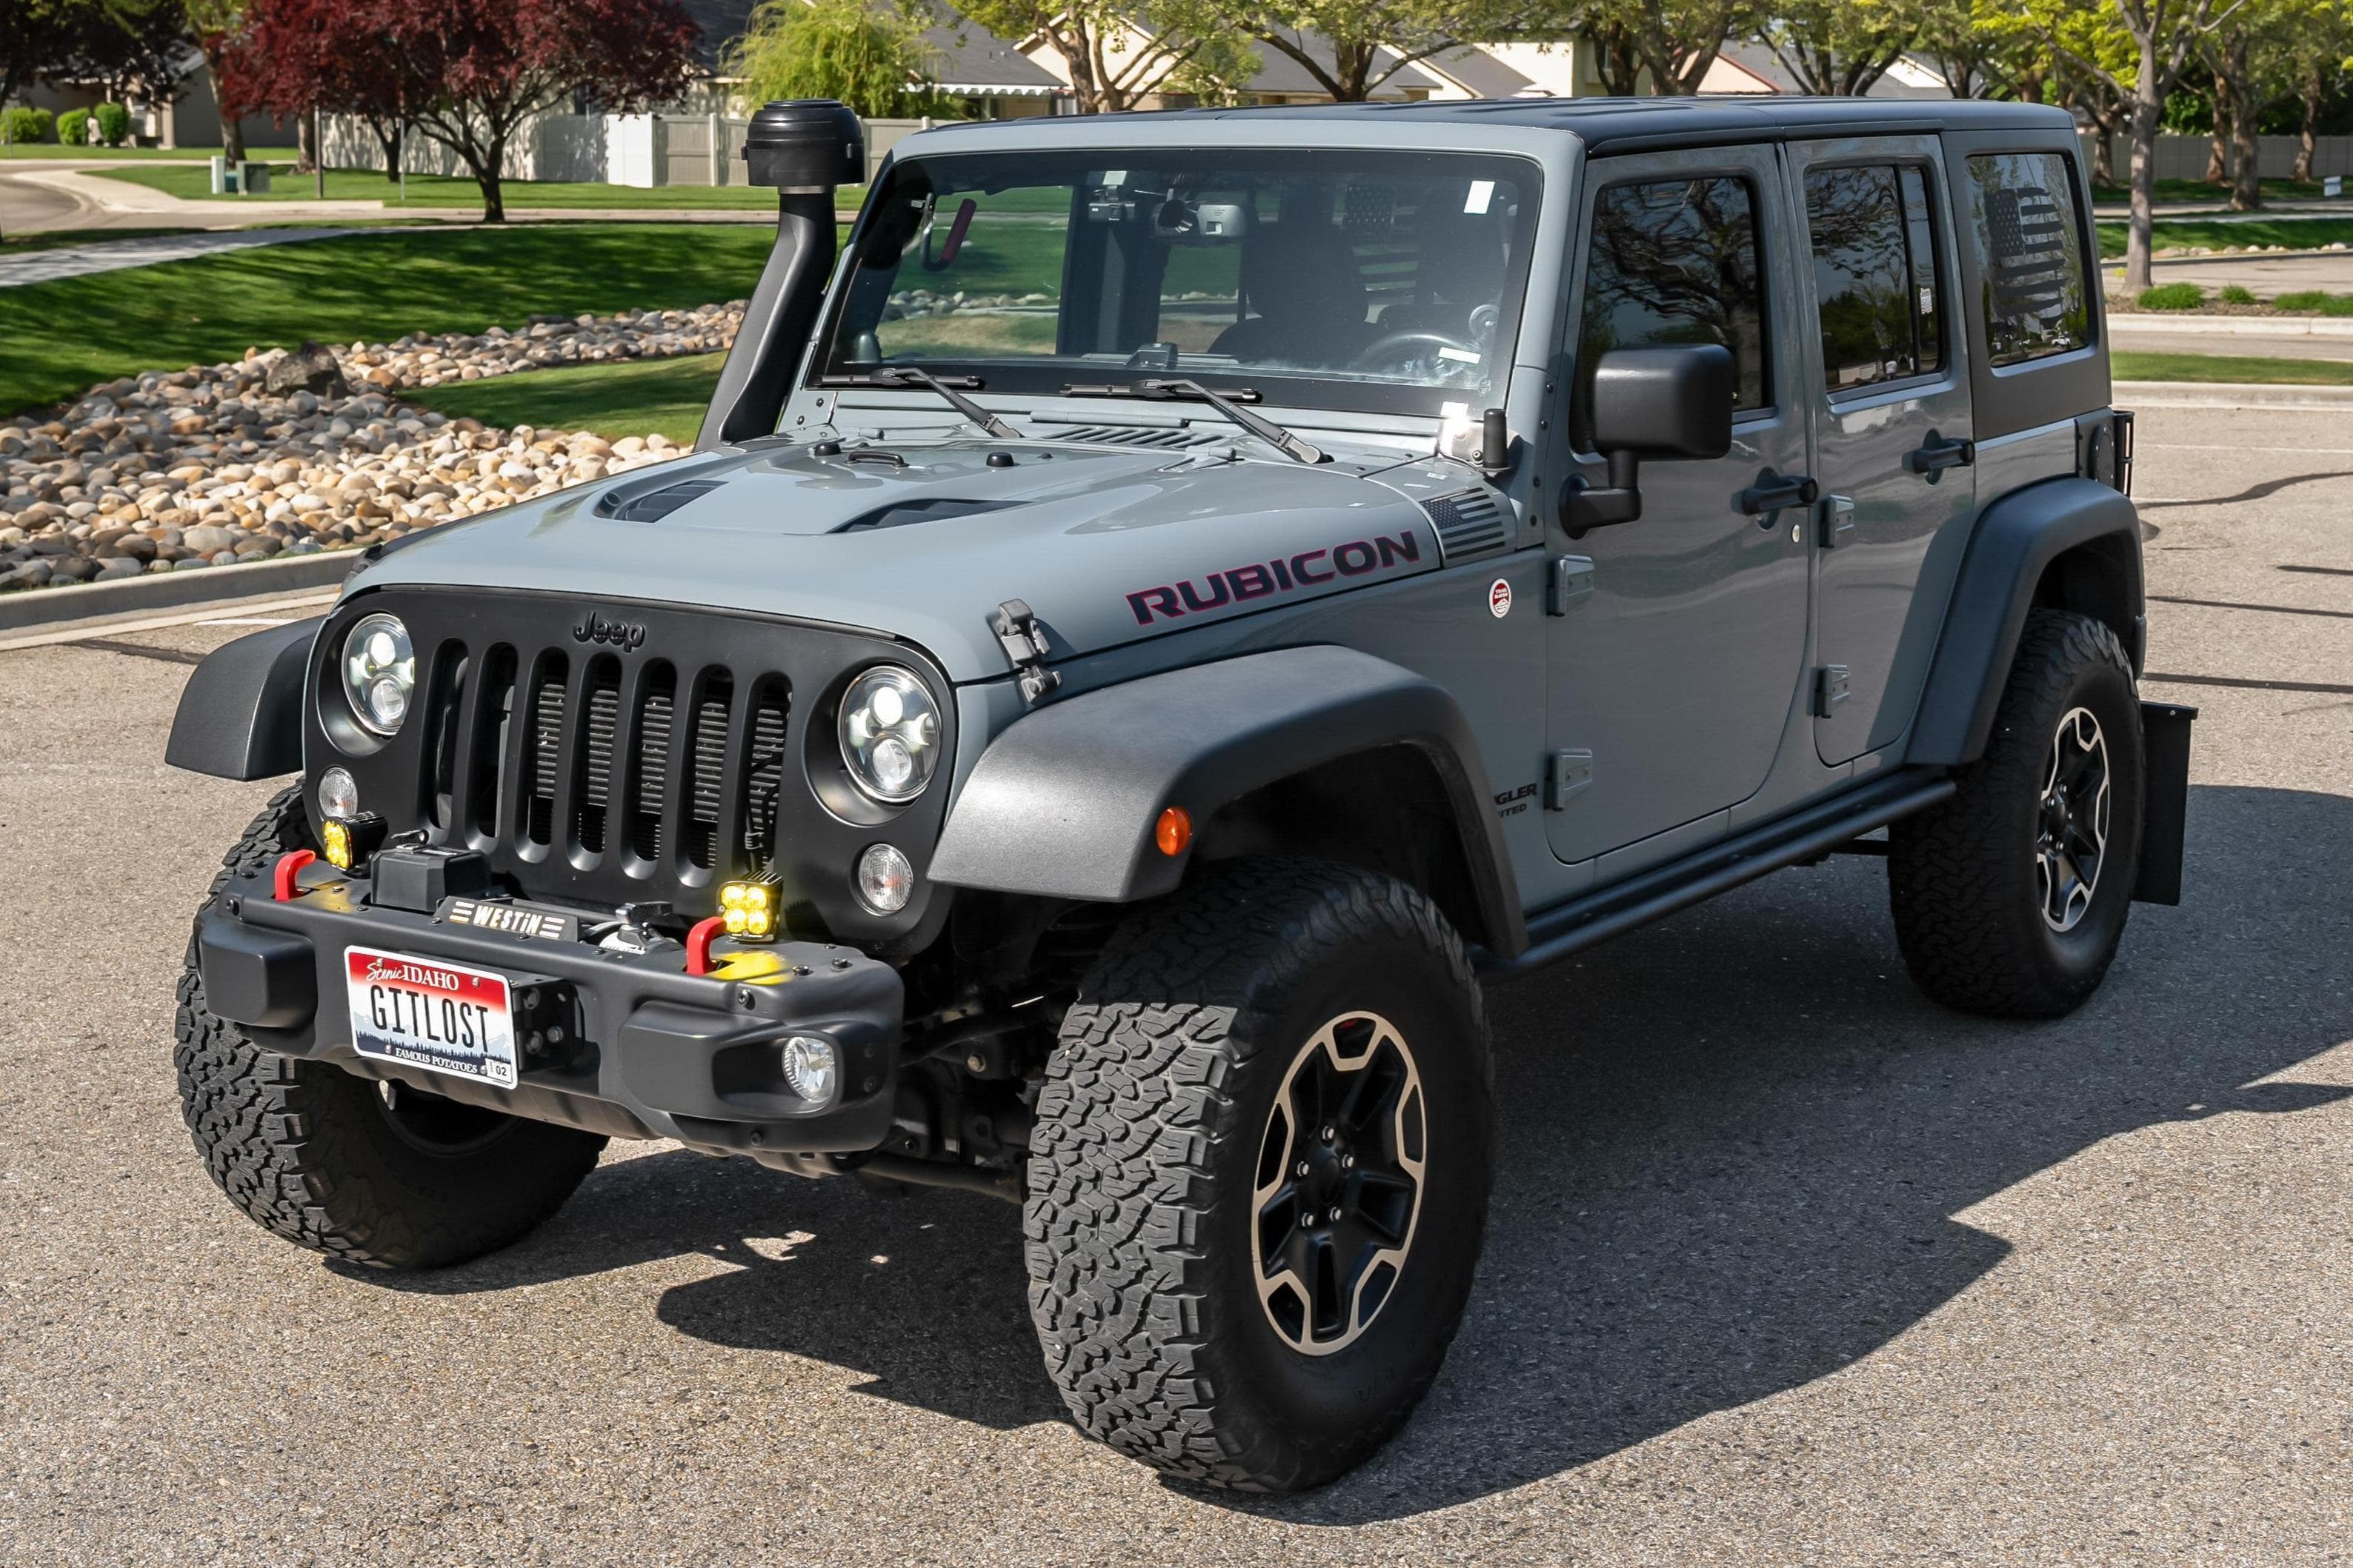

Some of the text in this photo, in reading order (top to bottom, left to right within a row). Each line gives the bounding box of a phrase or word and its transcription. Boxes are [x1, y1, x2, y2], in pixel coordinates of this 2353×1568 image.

[1125, 530, 1420, 626] RUBICON
[573, 612, 645, 653] Jeep
[1498, 803, 1528, 818] ITED
[366, 962, 459, 991] Scenic IDAHO
[370, 984, 488, 1053] GITLOST
[395, 1047, 430, 1064] FAMOUS
[430, 1055, 479, 1074] POTATOES
[496, 1065, 507, 1077] 02
